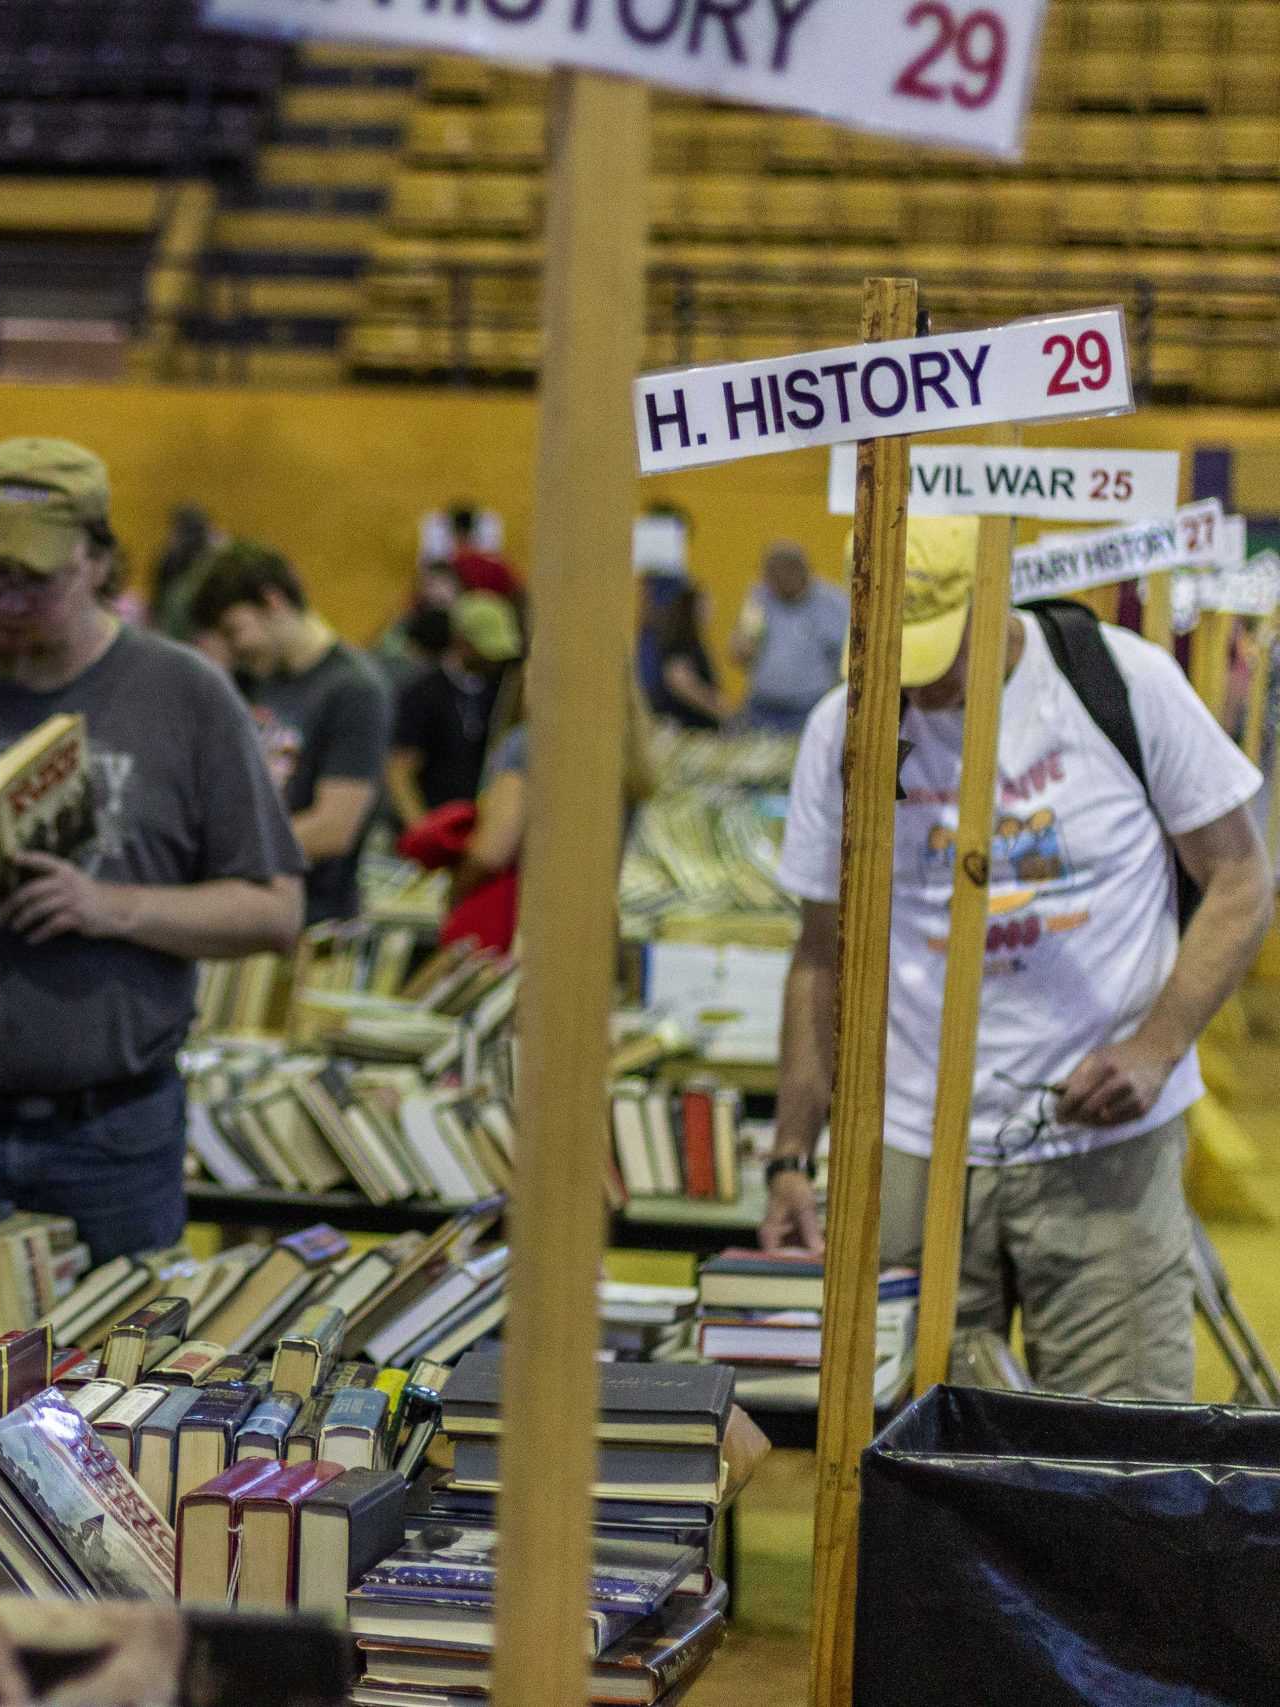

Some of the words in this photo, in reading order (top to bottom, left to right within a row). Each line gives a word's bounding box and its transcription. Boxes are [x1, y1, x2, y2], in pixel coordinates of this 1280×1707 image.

[894, 3, 1007, 109] 29
[645, 389, 707, 452] H.
[723, 345, 991, 441] HISTORY
[1042, 330, 1112, 397] 29
[908, 464, 974, 496] IVIL
[985, 464, 1076, 500] WAR
[1089, 469, 1136, 502] 25
[1084, 526, 1175, 573] HISTORY
[1183, 513, 1214, 551] 27
